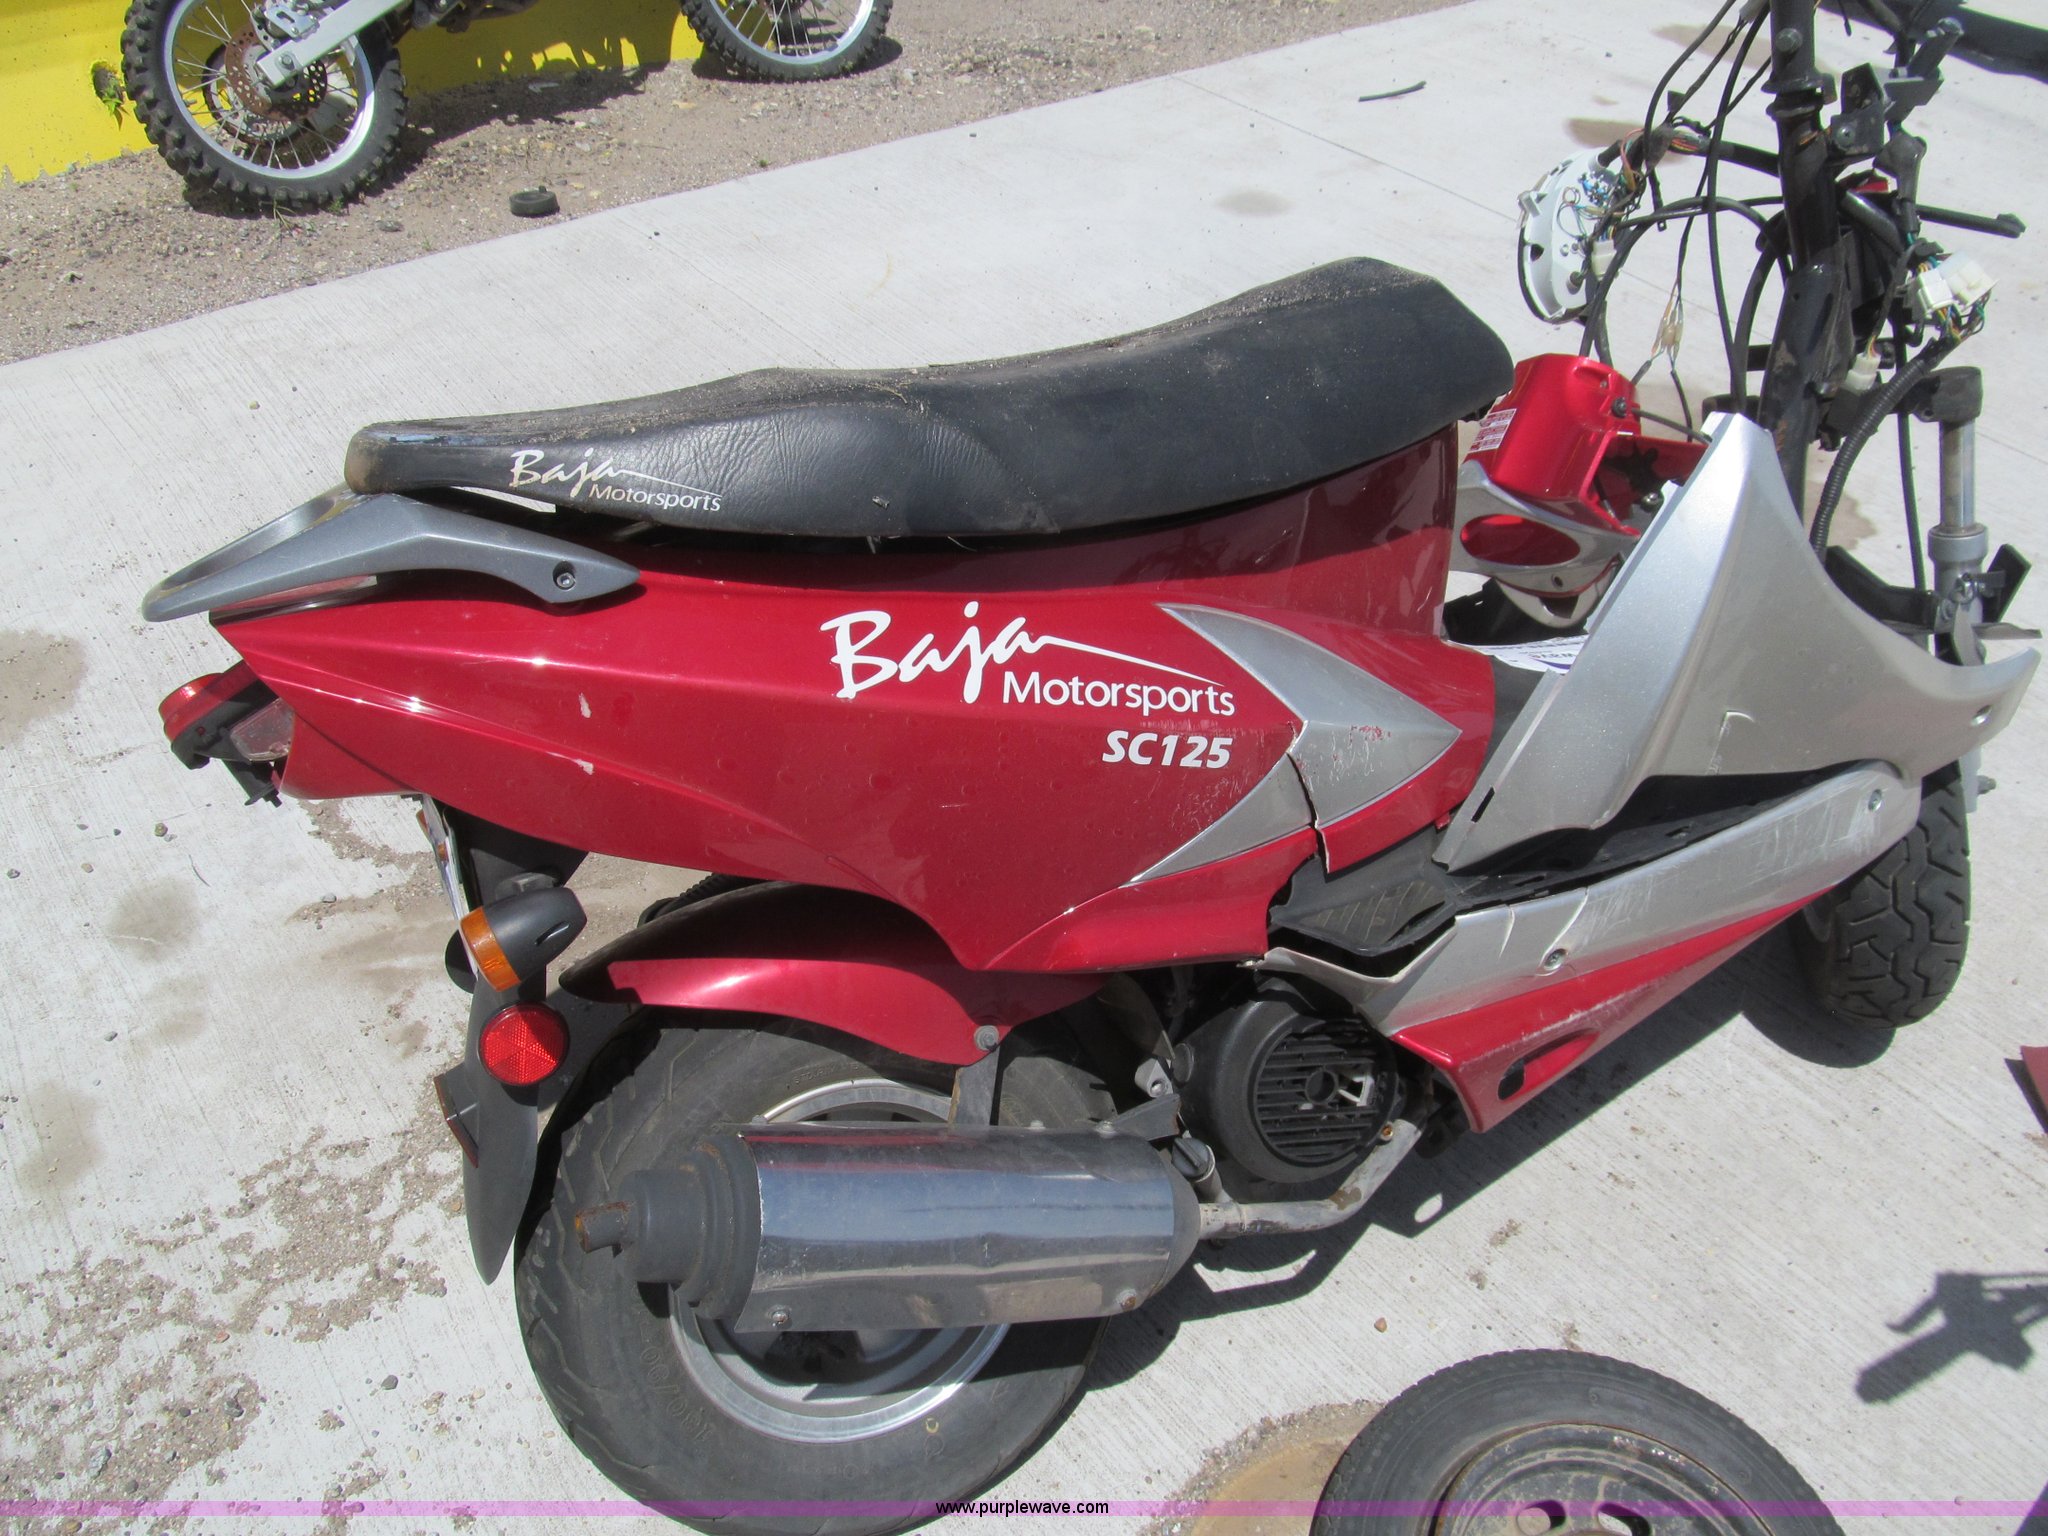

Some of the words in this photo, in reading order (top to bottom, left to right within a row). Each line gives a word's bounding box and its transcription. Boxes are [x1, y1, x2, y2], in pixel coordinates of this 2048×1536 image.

[509, 447, 636, 498] Baja
[588, 483, 723, 512] Motorsports
[820, 601, 1056, 704] Baja
[1002, 671, 1236, 717] Motorsports
[1102, 730, 1233, 769] SC125
